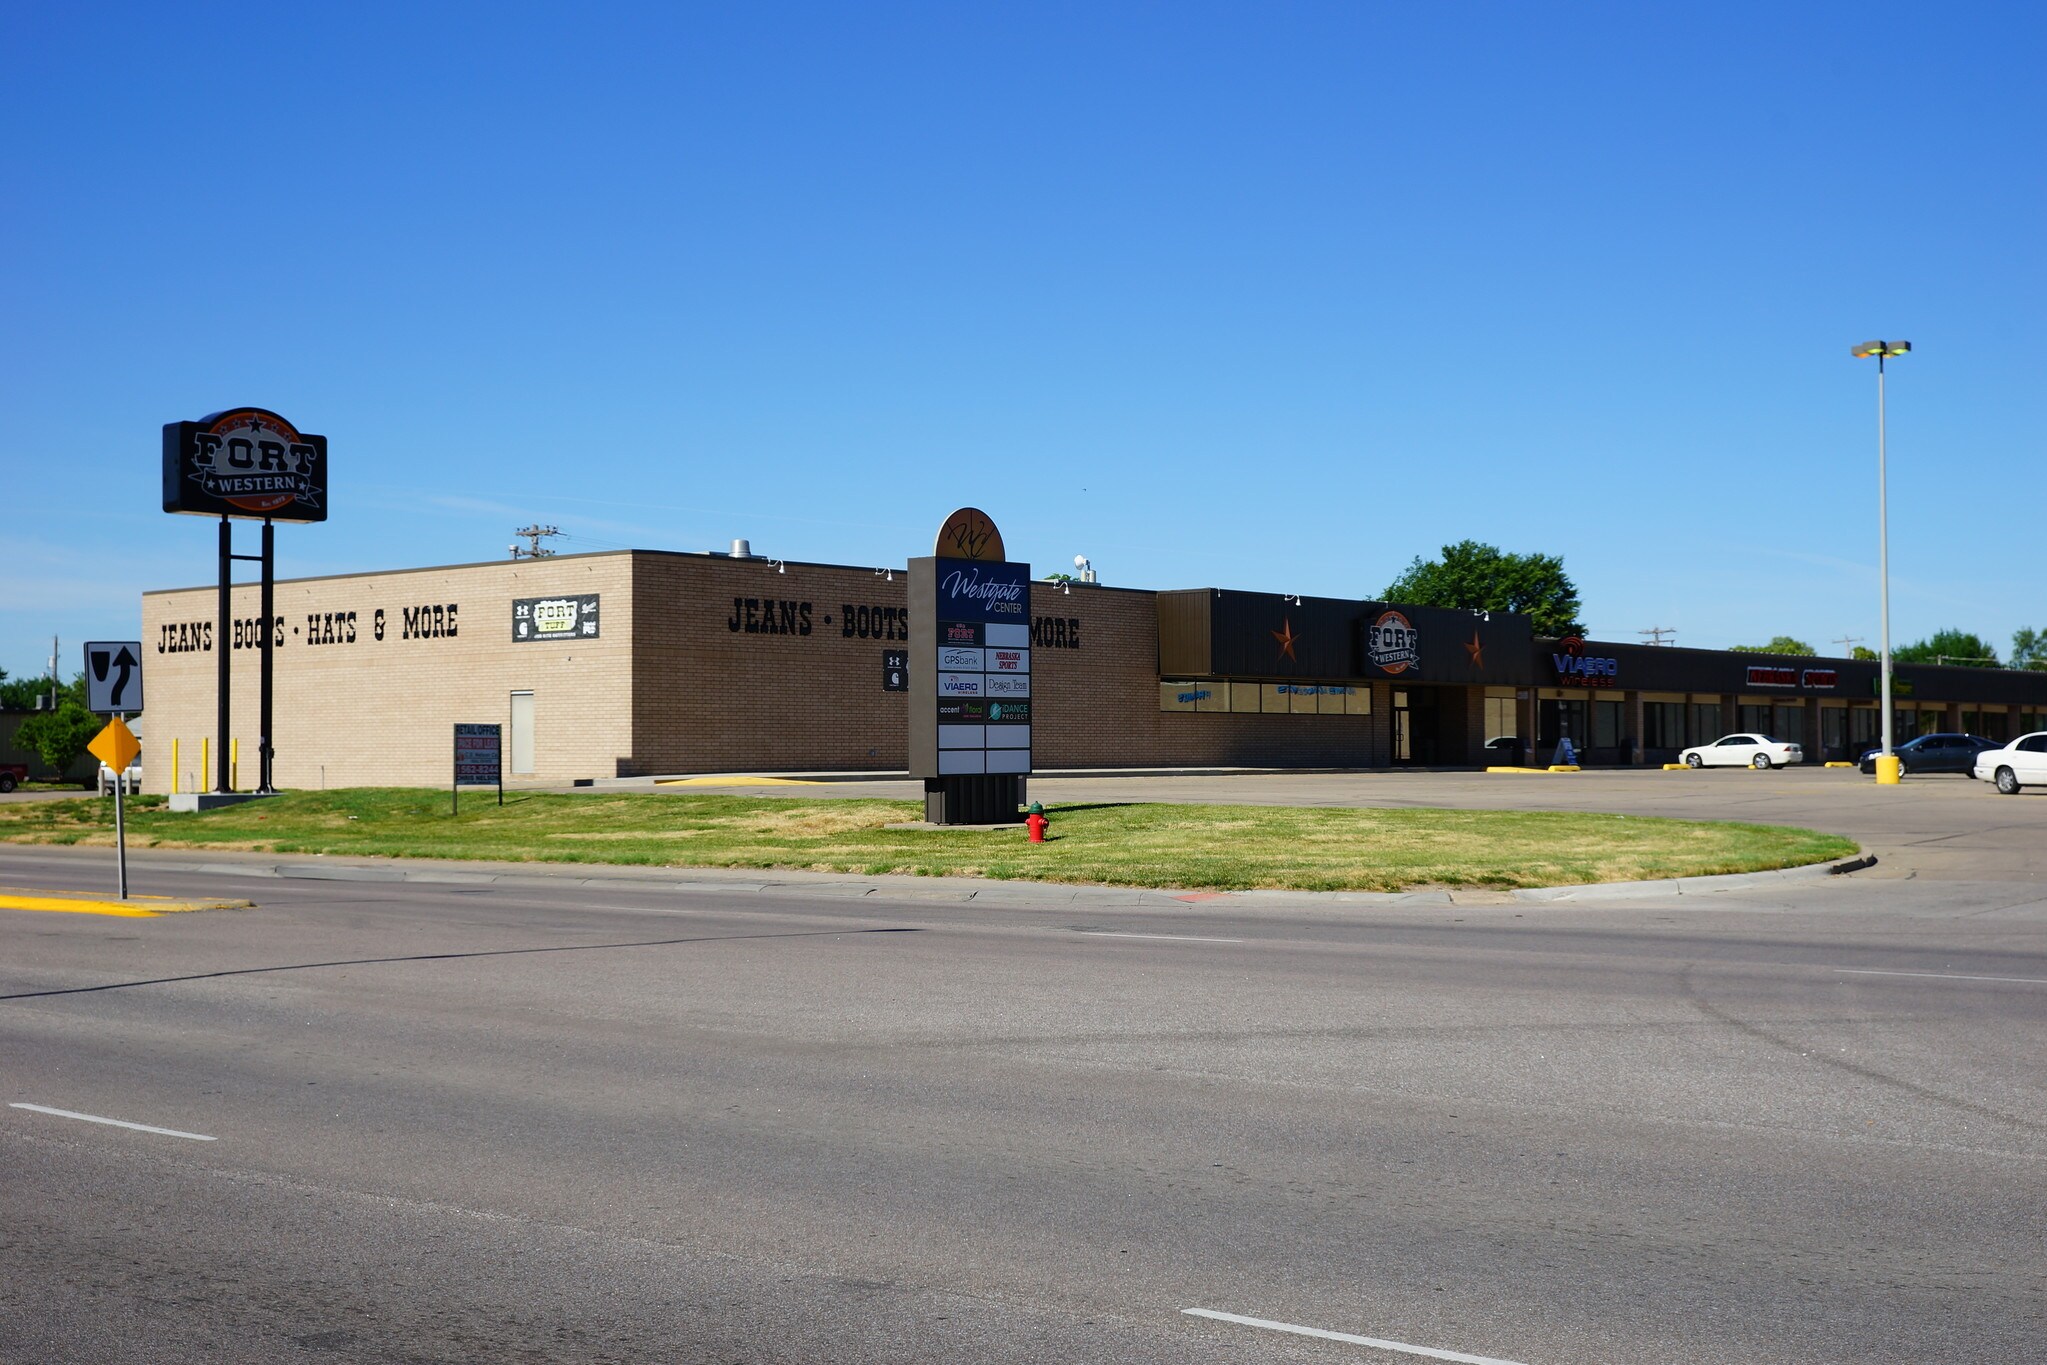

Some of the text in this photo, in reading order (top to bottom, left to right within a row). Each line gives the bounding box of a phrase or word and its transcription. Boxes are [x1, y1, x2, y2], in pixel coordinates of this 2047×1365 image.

[194, 432, 317, 476] FORT
[218, 476, 296, 492] WESTERN
[941, 568, 1026, 611] Westgate
[538, 604, 575, 619] FORT
[994, 602, 1022, 614] CENTER
[157, 603, 458, 653] JEANS BOOS HATS & MORE
[728, 597, 1079, 649] JEANS BOOTS MORE
[947, 628, 975, 639] FORT
[1370, 625, 1418, 649] FORT
[944, 655, 978, 665] GPSbank
[995, 652, 1020, 660] NEBRASKA
[1379, 650, 1410, 663] WESTERN
[998, 661, 1018, 670] SPORTS
[1552, 653, 1617, 677] VIAERO
[944, 683, 978, 691] VIAERO
[988, 678, 1027, 693] Design Team
[940, 706, 960, 714] accent
